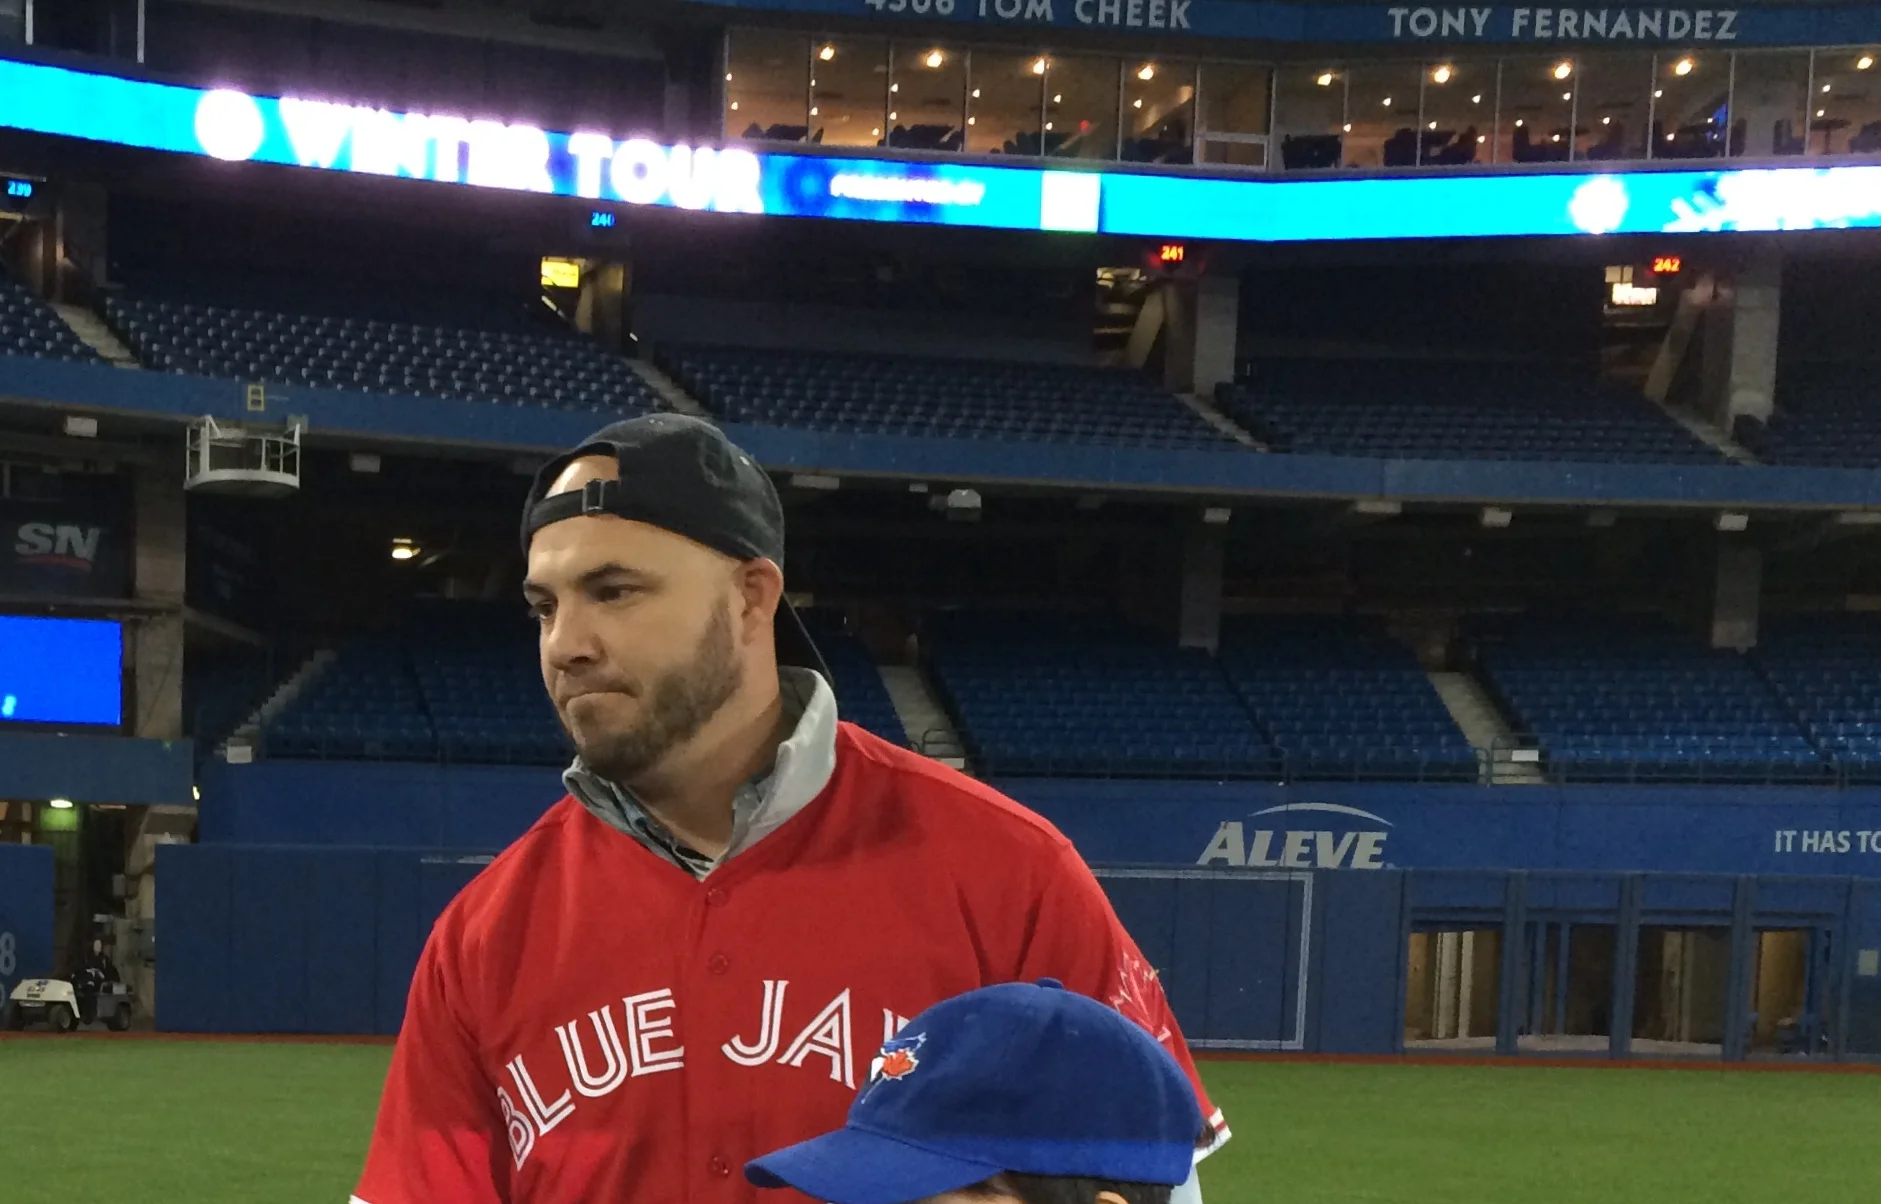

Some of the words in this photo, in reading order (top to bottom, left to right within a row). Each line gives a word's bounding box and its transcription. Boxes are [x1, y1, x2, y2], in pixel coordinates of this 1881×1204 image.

[977, 0, 1055, 22] TOM
[1074, 0, 1191, 29] CHEEK
[1388, 7, 1492, 37] TONY
[1511, 8, 1738, 40] FERNANDEZ
[278, 97, 555, 194] WINTER
[567, 132, 766, 214] TOUR
[1161, 245, 1184, 261] 241
[1654, 258, 1680, 272] 242
[15, 522, 101, 562] SN
[1196, 820, 1389, 870] ALEVE
[1774, 829, 1798, 853] IT
[1801, 829, 1851, 854] HAS
[496, 987, 686, 1173] BLUE
[721, 979, 911, 1091] JA
